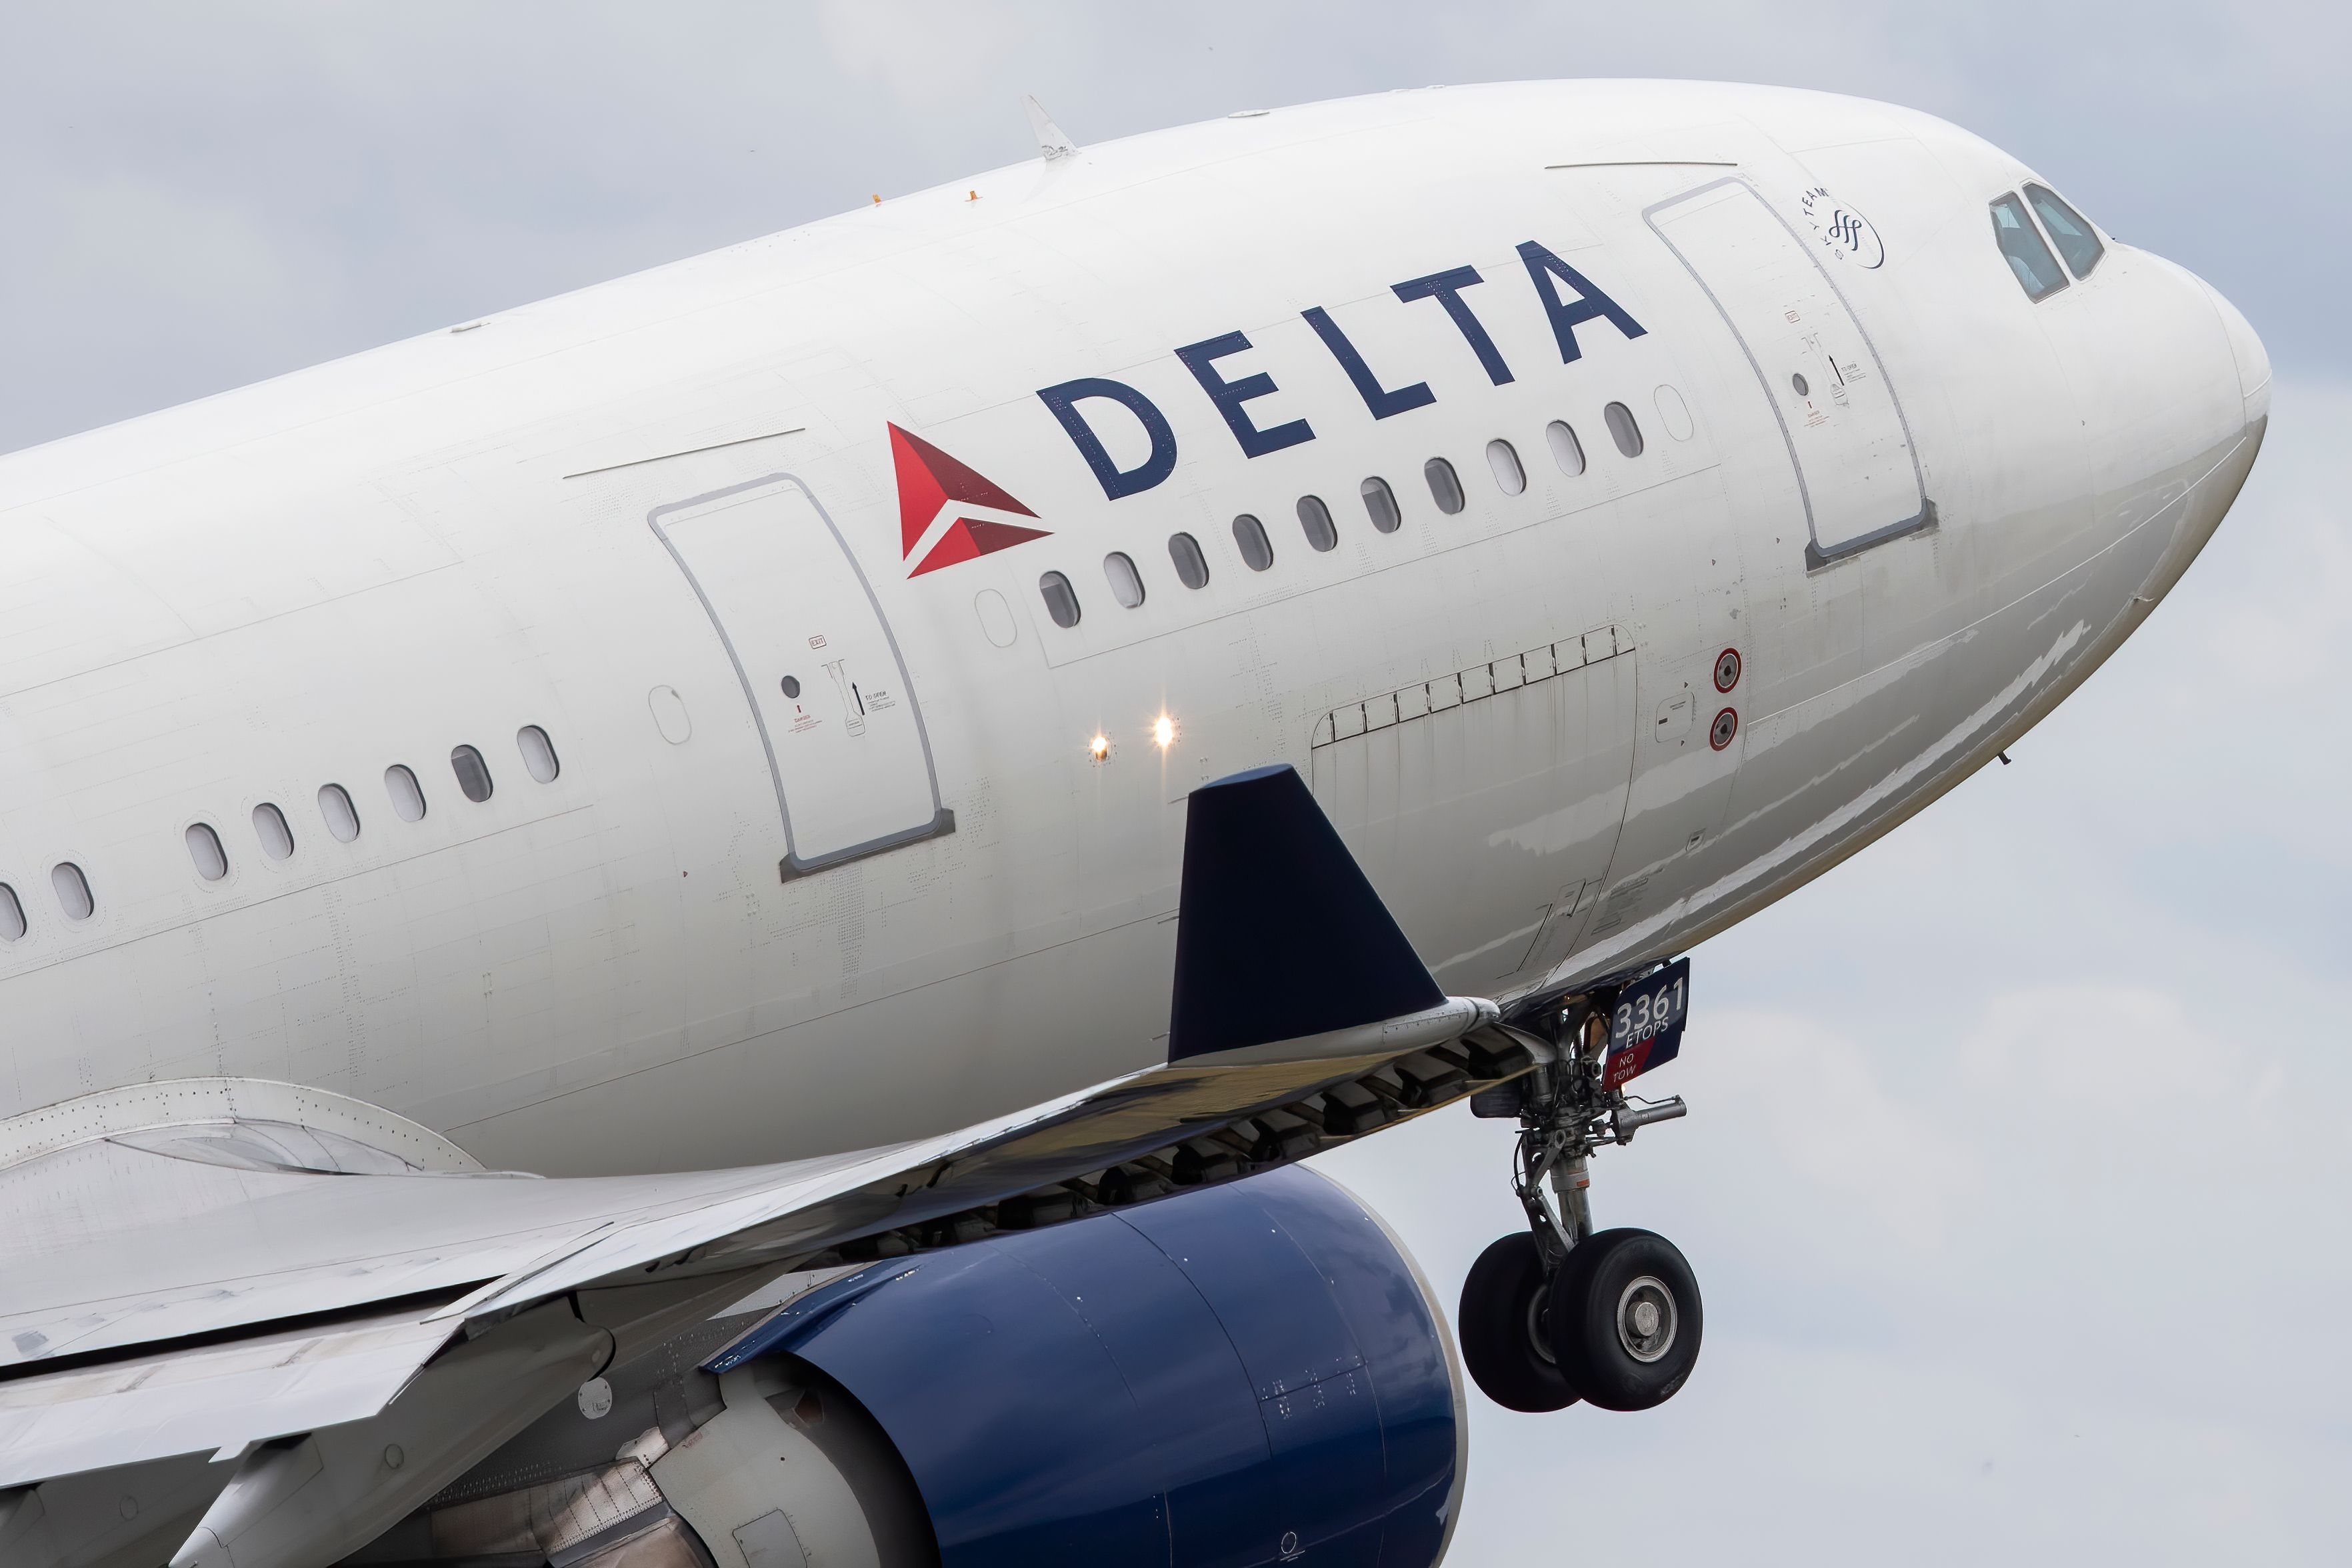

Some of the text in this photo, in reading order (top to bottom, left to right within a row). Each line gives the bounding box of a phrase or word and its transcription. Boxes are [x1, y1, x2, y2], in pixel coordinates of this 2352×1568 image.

[1036, 240, 1649, 501] DELTA
[1615, 977, 1683, 1039] 3361
[1625, 1016, 1669, 1049] ETOPS
[1613, 1064, 1636, 1083] TOW
[1619, 1053, 1634, 1067] NO
